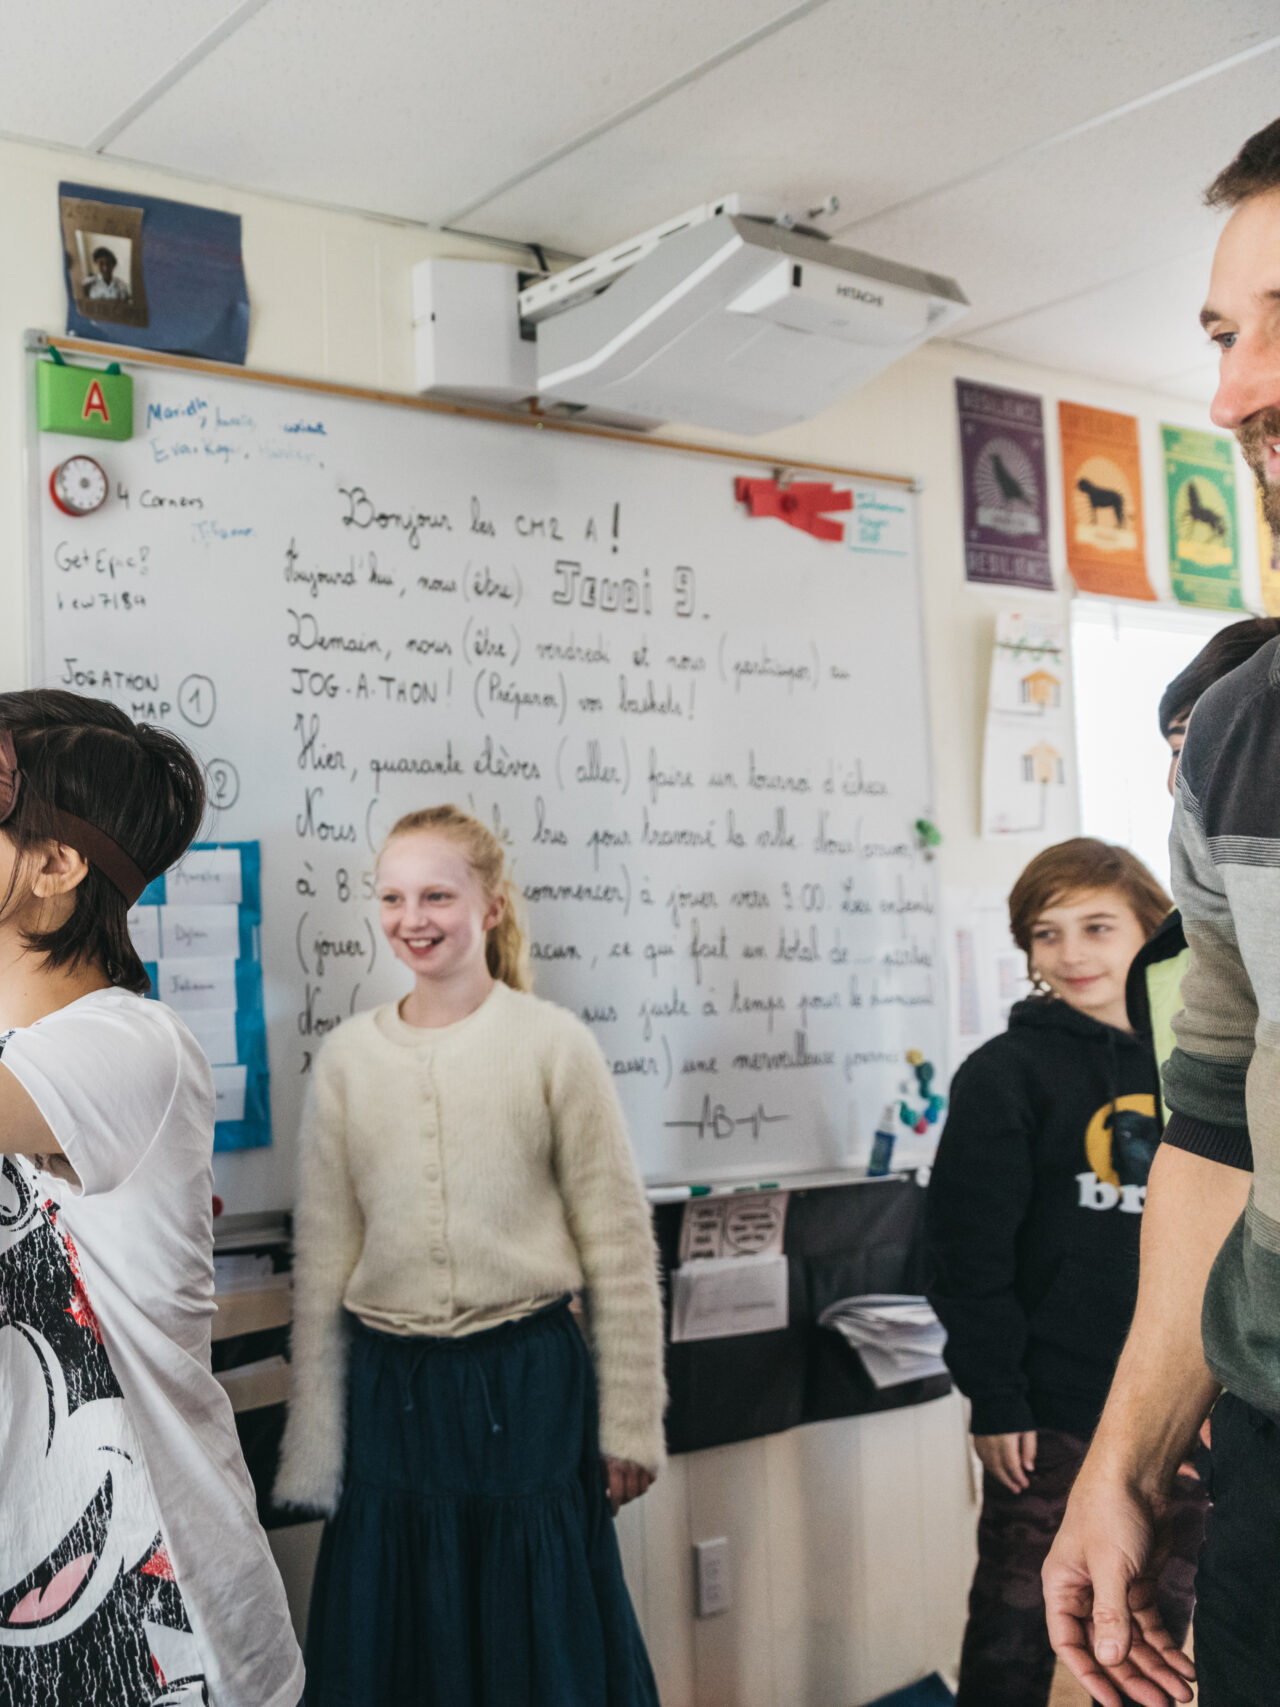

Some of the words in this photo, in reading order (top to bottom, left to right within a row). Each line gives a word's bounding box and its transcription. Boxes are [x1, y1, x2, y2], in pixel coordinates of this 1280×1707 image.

[836, 284, 884, 307] HITACHI
[82, 379, 111, 423] A
[116, 482, 130, 509] 4
[139, 489, 204, 509] Corners
[338, 486, 452, 550] Bonjour
[470, 496, 496, 537] les
[552, 559, 652, 616] Jeudi
[131, 700, 172, 720] MAP
[296, 861, 317, 897] à
[1075, 1171, 1148, 1214] br
